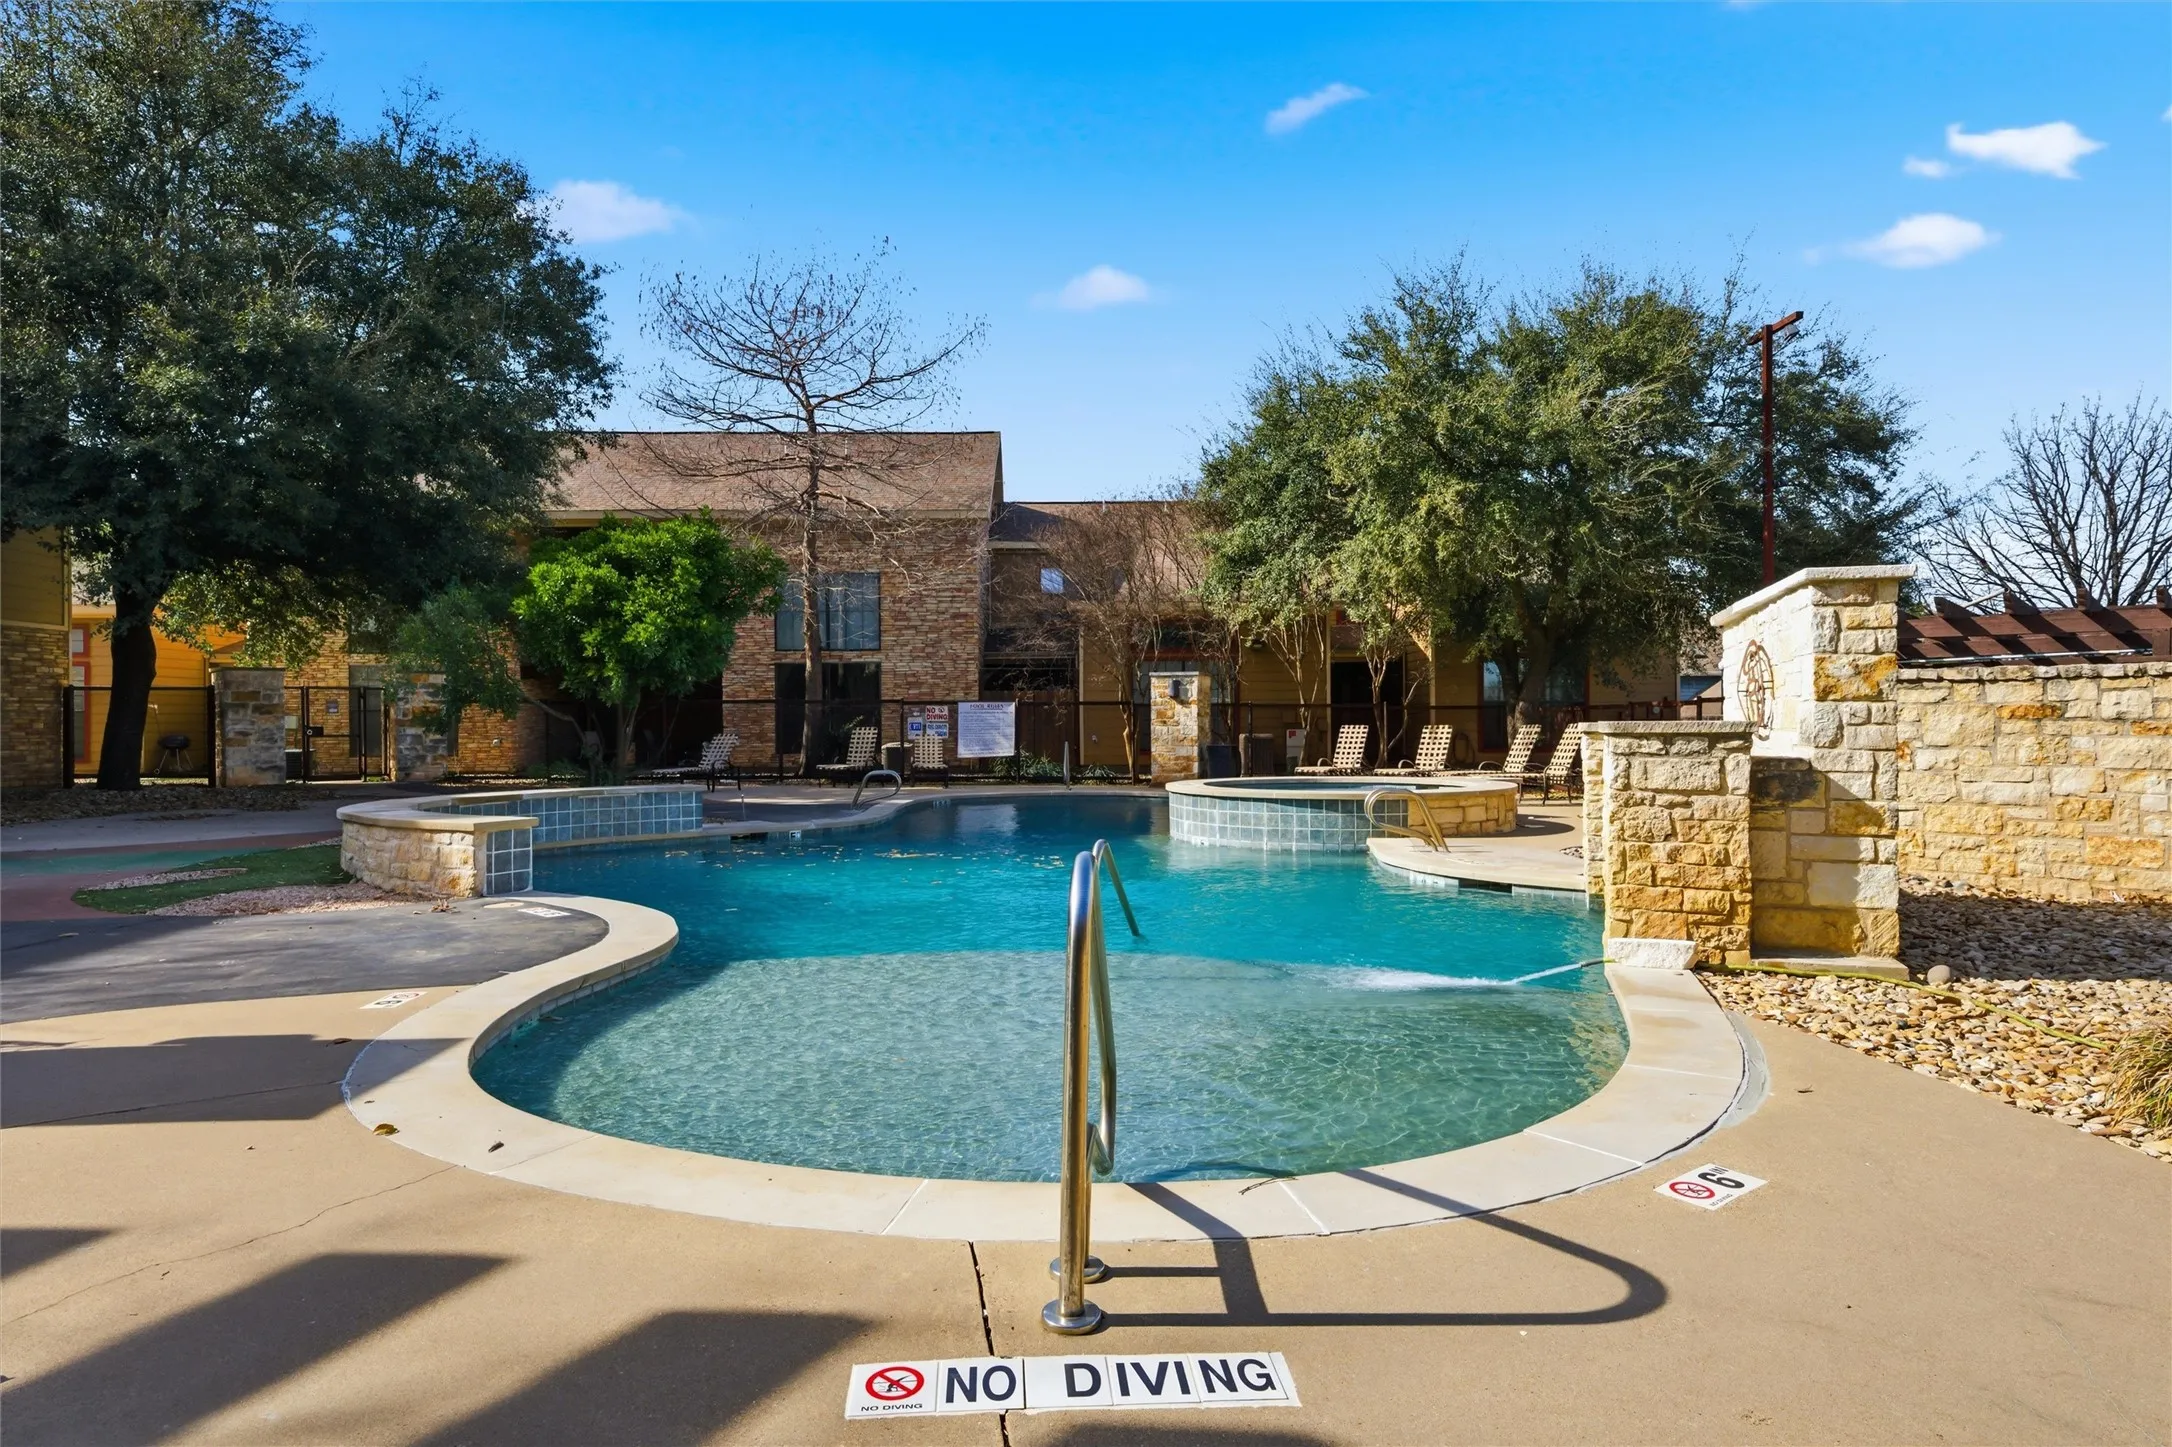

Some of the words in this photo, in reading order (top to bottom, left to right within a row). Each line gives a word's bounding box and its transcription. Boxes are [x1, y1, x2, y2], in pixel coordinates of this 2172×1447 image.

[944, 1365, 1017, 1403] NO
[1064, 1358, 1277, 1398] DIVING
[882, 1403, 923, 1411] DIVING
